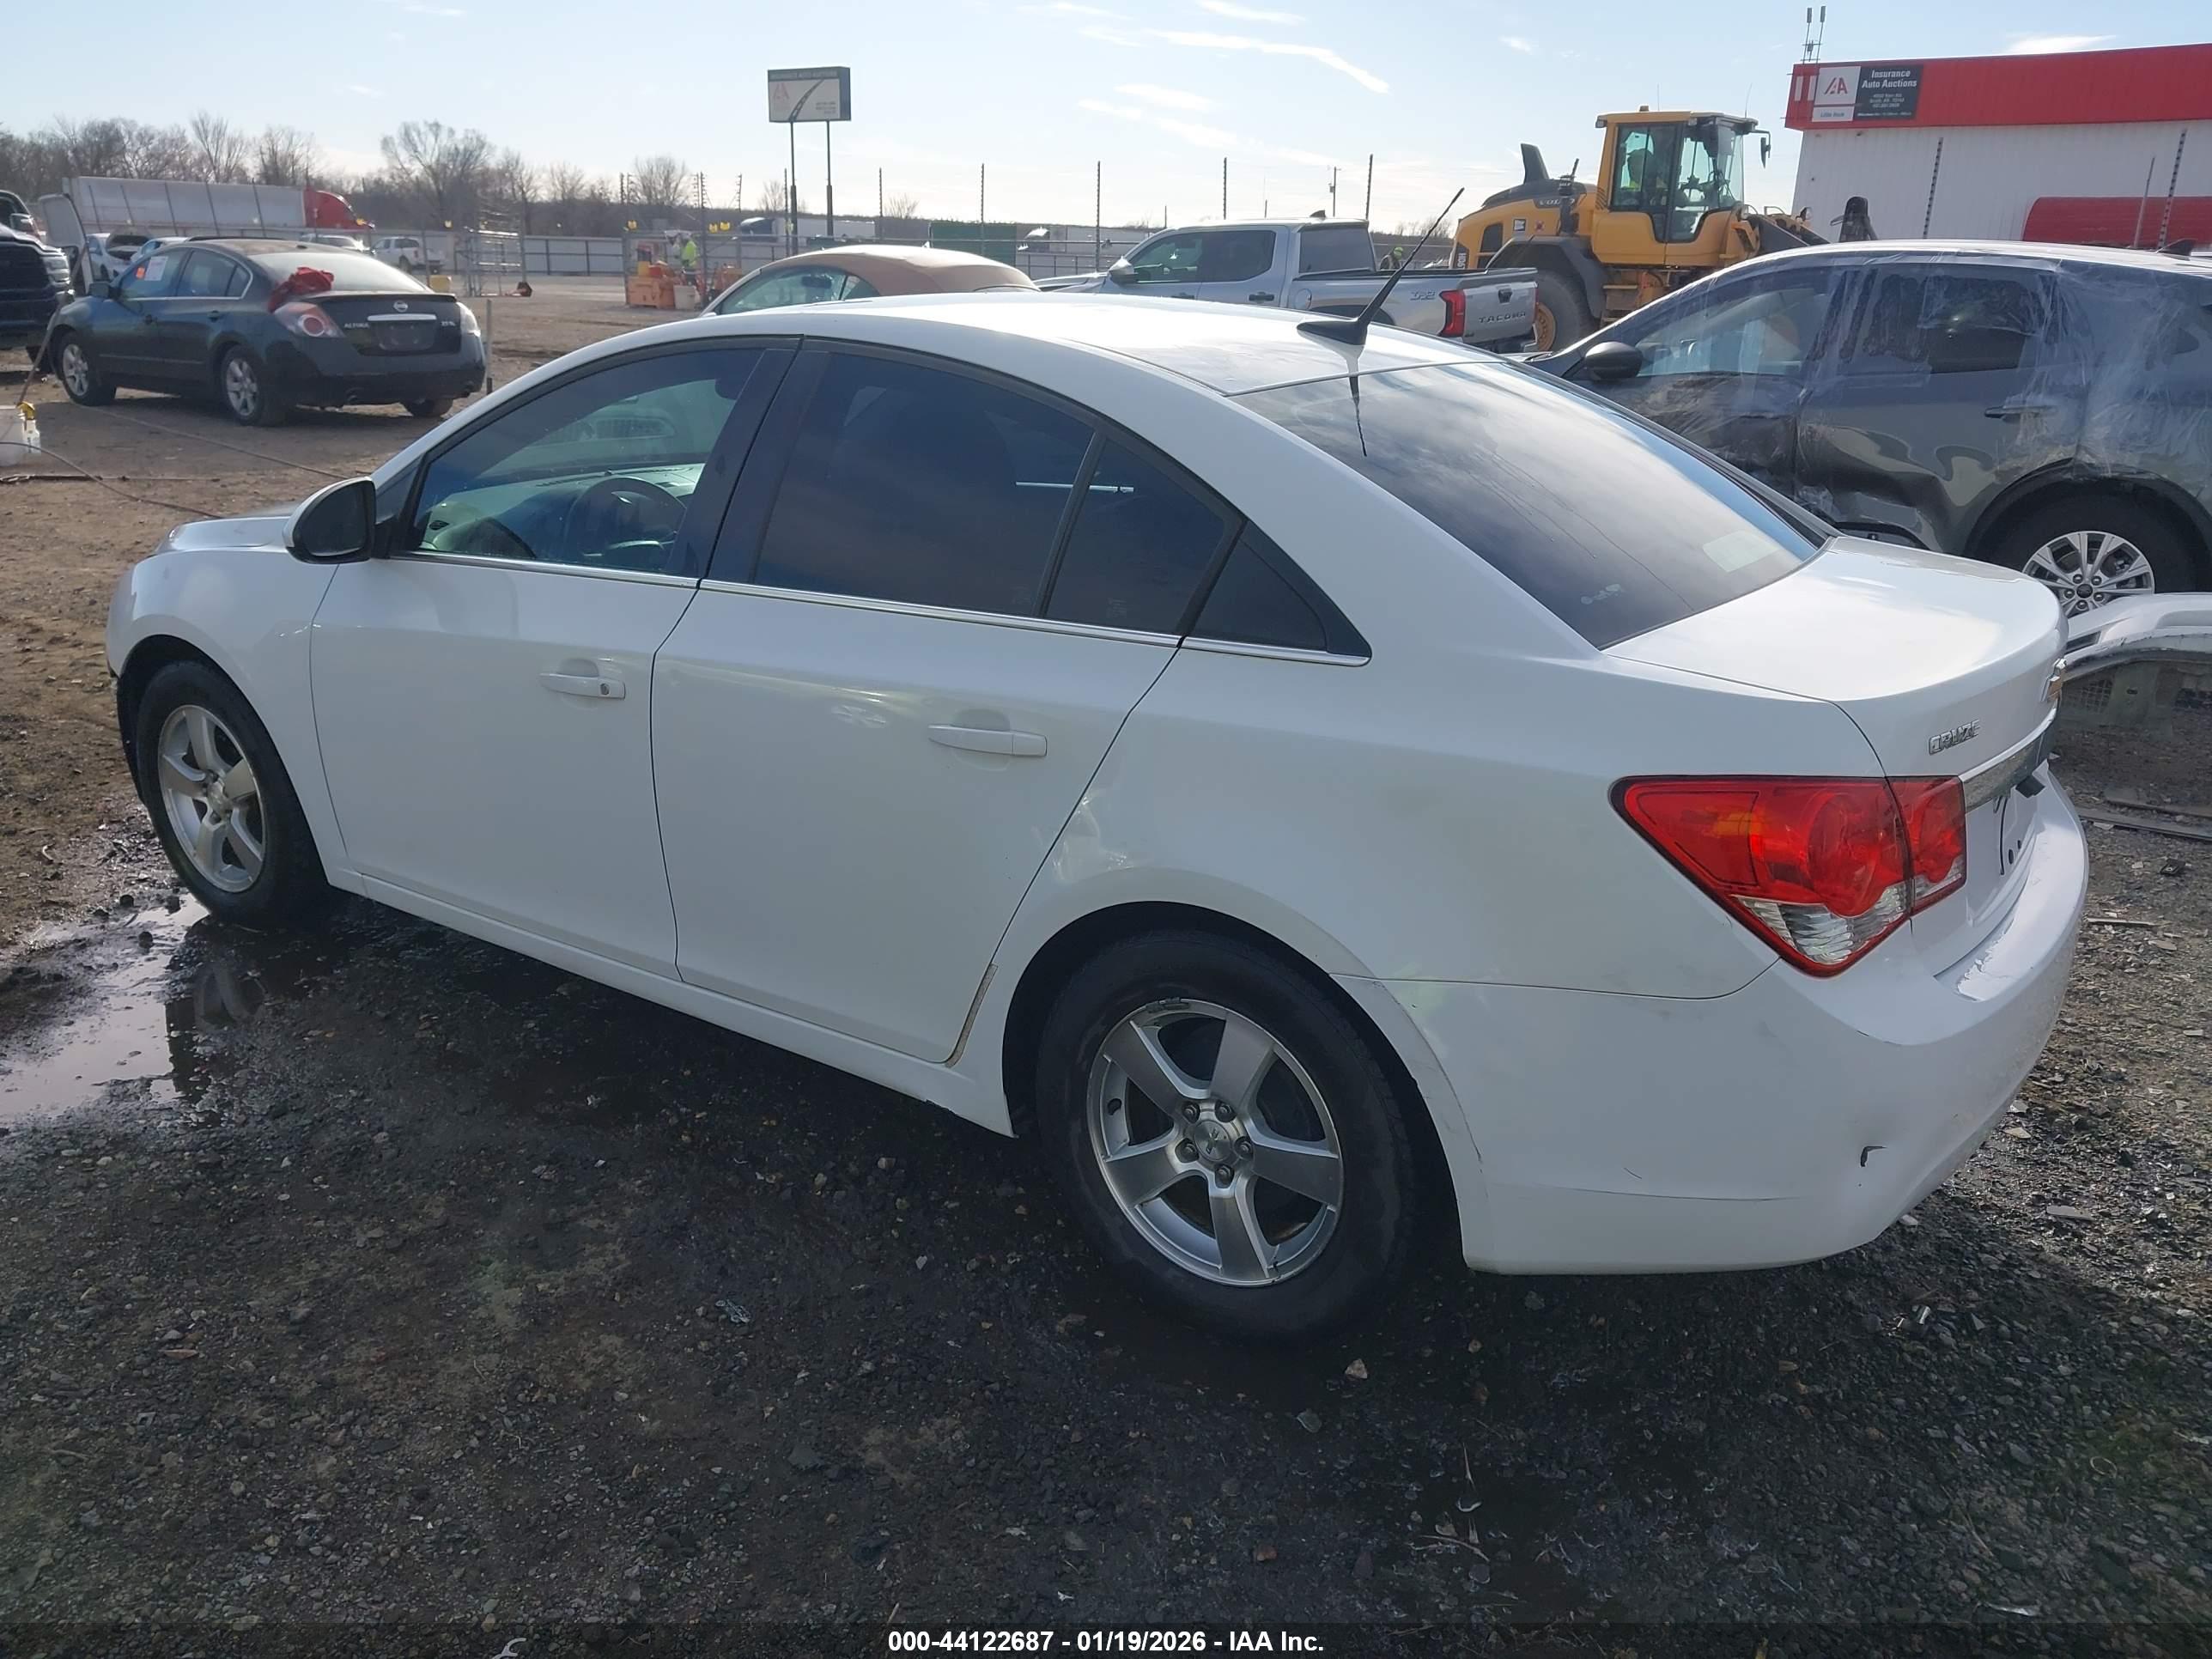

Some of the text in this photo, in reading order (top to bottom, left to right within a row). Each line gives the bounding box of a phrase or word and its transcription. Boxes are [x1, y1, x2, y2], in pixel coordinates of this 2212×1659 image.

[1871, 70, 1911, 79] Insurance
[1862, 78, 1917, 88] Auto Auctions
[1479, 312, 1526, 323] TACOMA
[1929, 719, 1980, 756] CRUZE
